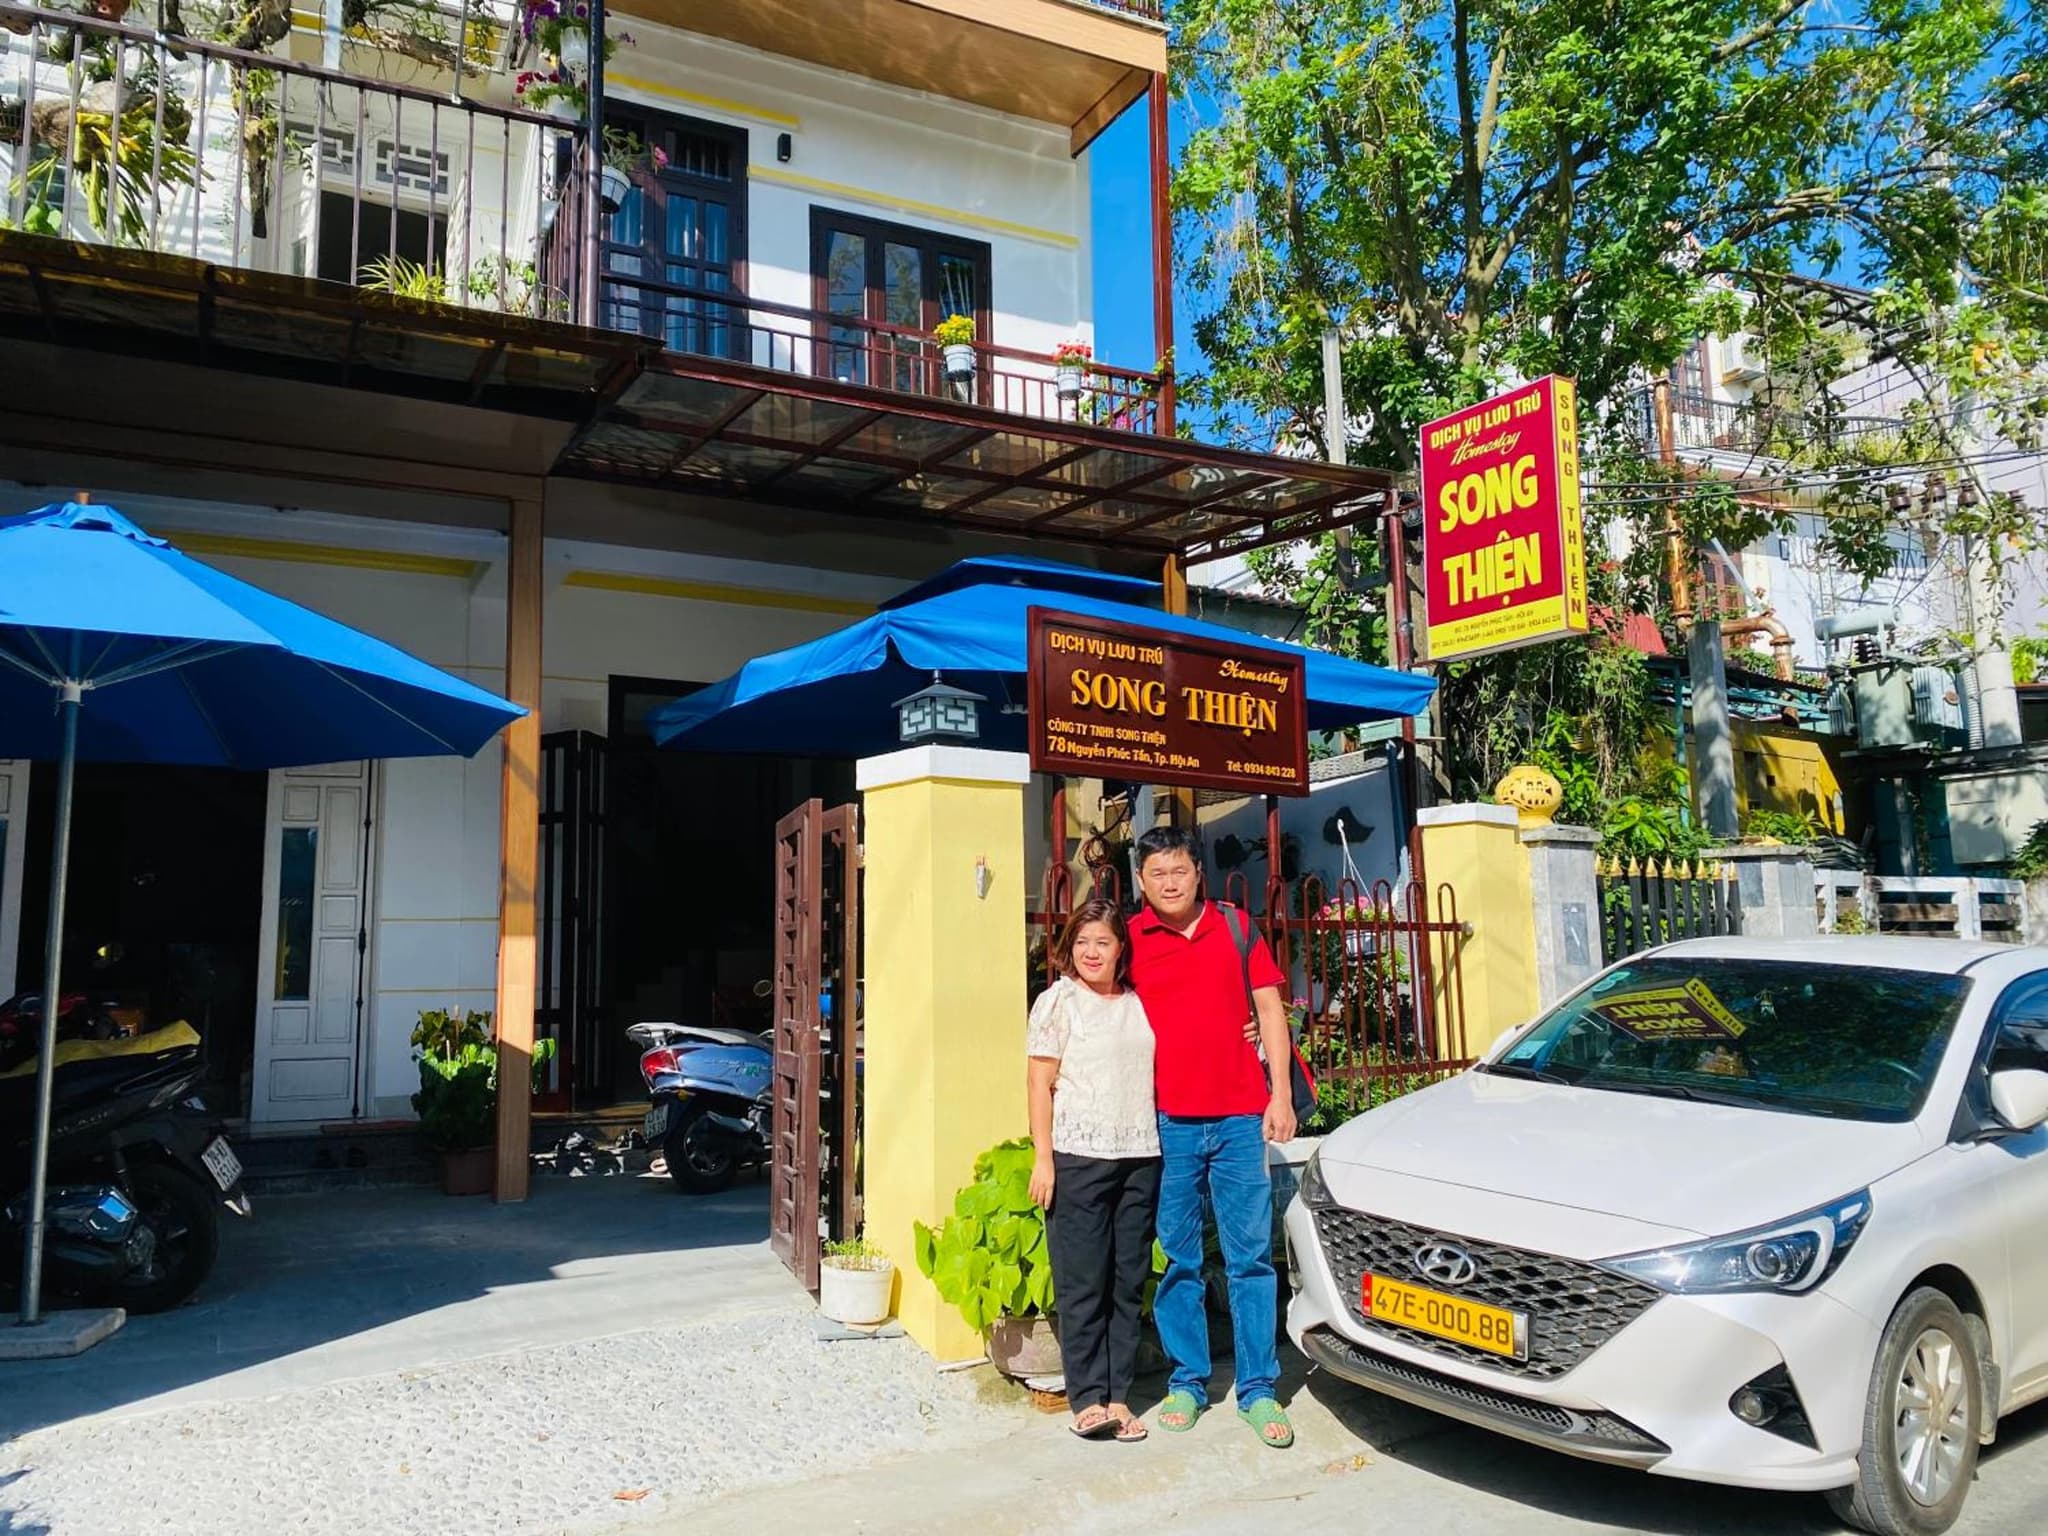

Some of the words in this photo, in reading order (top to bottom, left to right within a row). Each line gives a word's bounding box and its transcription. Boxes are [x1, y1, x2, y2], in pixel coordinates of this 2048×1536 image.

[1430, 424, 1461, 450] DỊCH
[1464, 415, 1482, 436] VỤ
[1485, 402, 1512, 429] LƯU
[1514, 389, 1542, 418] TRÚ
[1450, 431, 1521, 466] Homestay
[1440, 454, 1539, 533] SONG
[1443, 531, 1543, 607] THIỆN
[1051, 632, 1085, 654] DỊCH
[1087, 638, 1106, 660] VỤ
[1108, 642, 1136, 660] LƯU
[1137, 646, 1163, 665] TRÚ
[1218, 659, 1289, 693] Homestay
[1071, 668, 1168, 717] SONG
[1182, 690, 1278, 737] THIỆN
[1047, 735, 1066, 753] 78
[1106, 746, 1131, 760] Phúc
[1153, 751, 1169, 767] Tp.
[1074, 722, 1088, 736] TY
[1115, 728, 1140, 742] SONG
[1375, 1286, 1511, 1346] 47E-000.88
